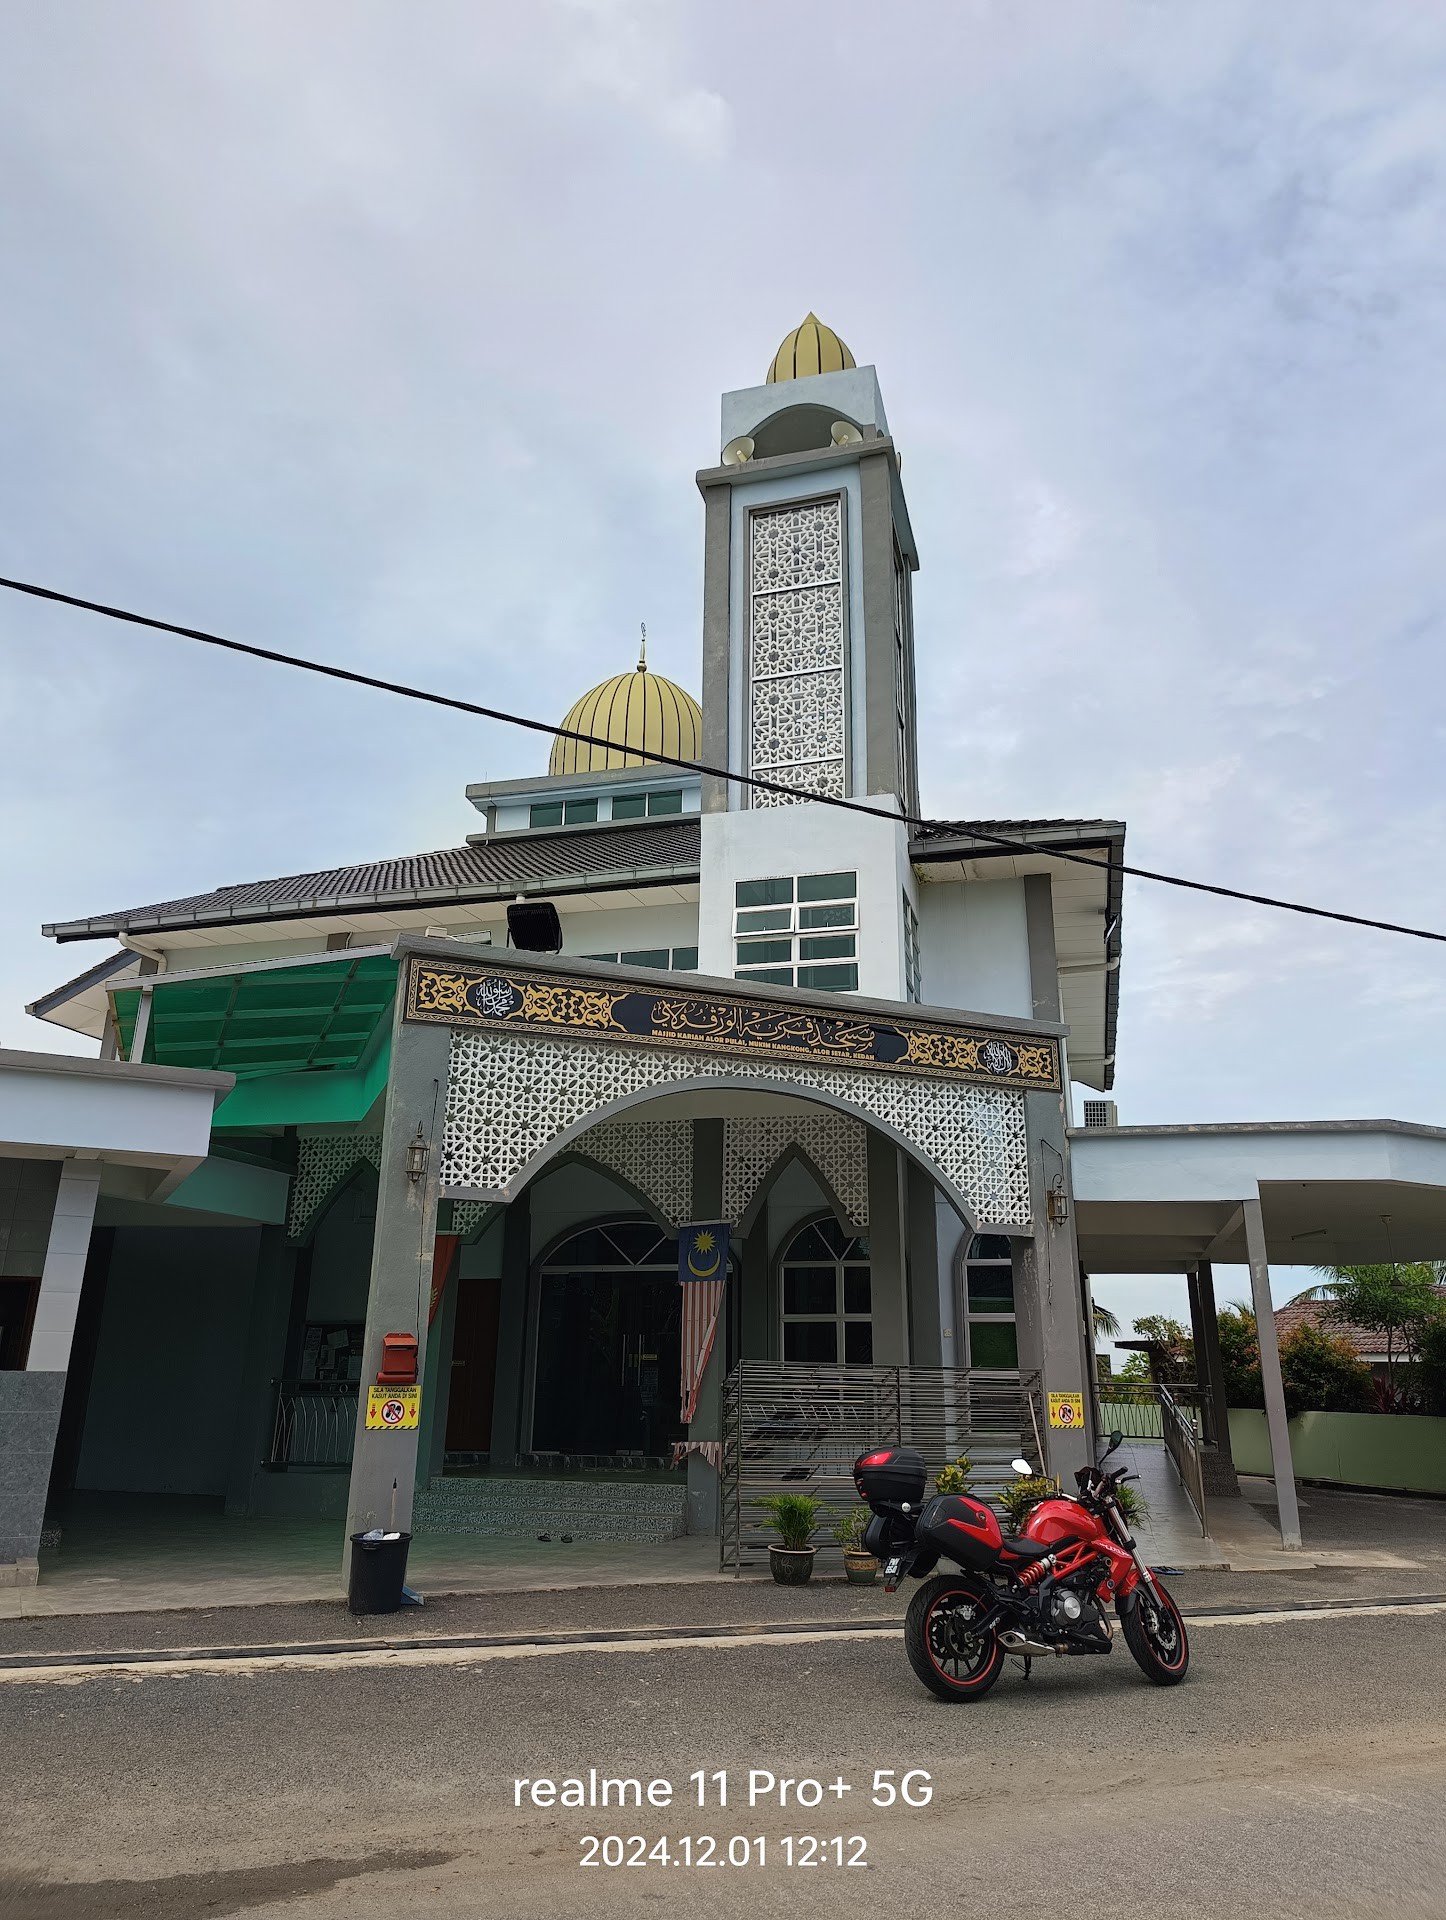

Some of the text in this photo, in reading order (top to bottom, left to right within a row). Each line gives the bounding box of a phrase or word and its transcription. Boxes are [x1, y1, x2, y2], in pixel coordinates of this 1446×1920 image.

[652, 1029, 676, 1038] MASJID
[677, 1032, 704, 1041] KARIAH
[705, 1035, 724, 1043] ALOR
[813, 1048, 830, 1056] ALOR
[853, 1052, 875, 1061] KEDAH
